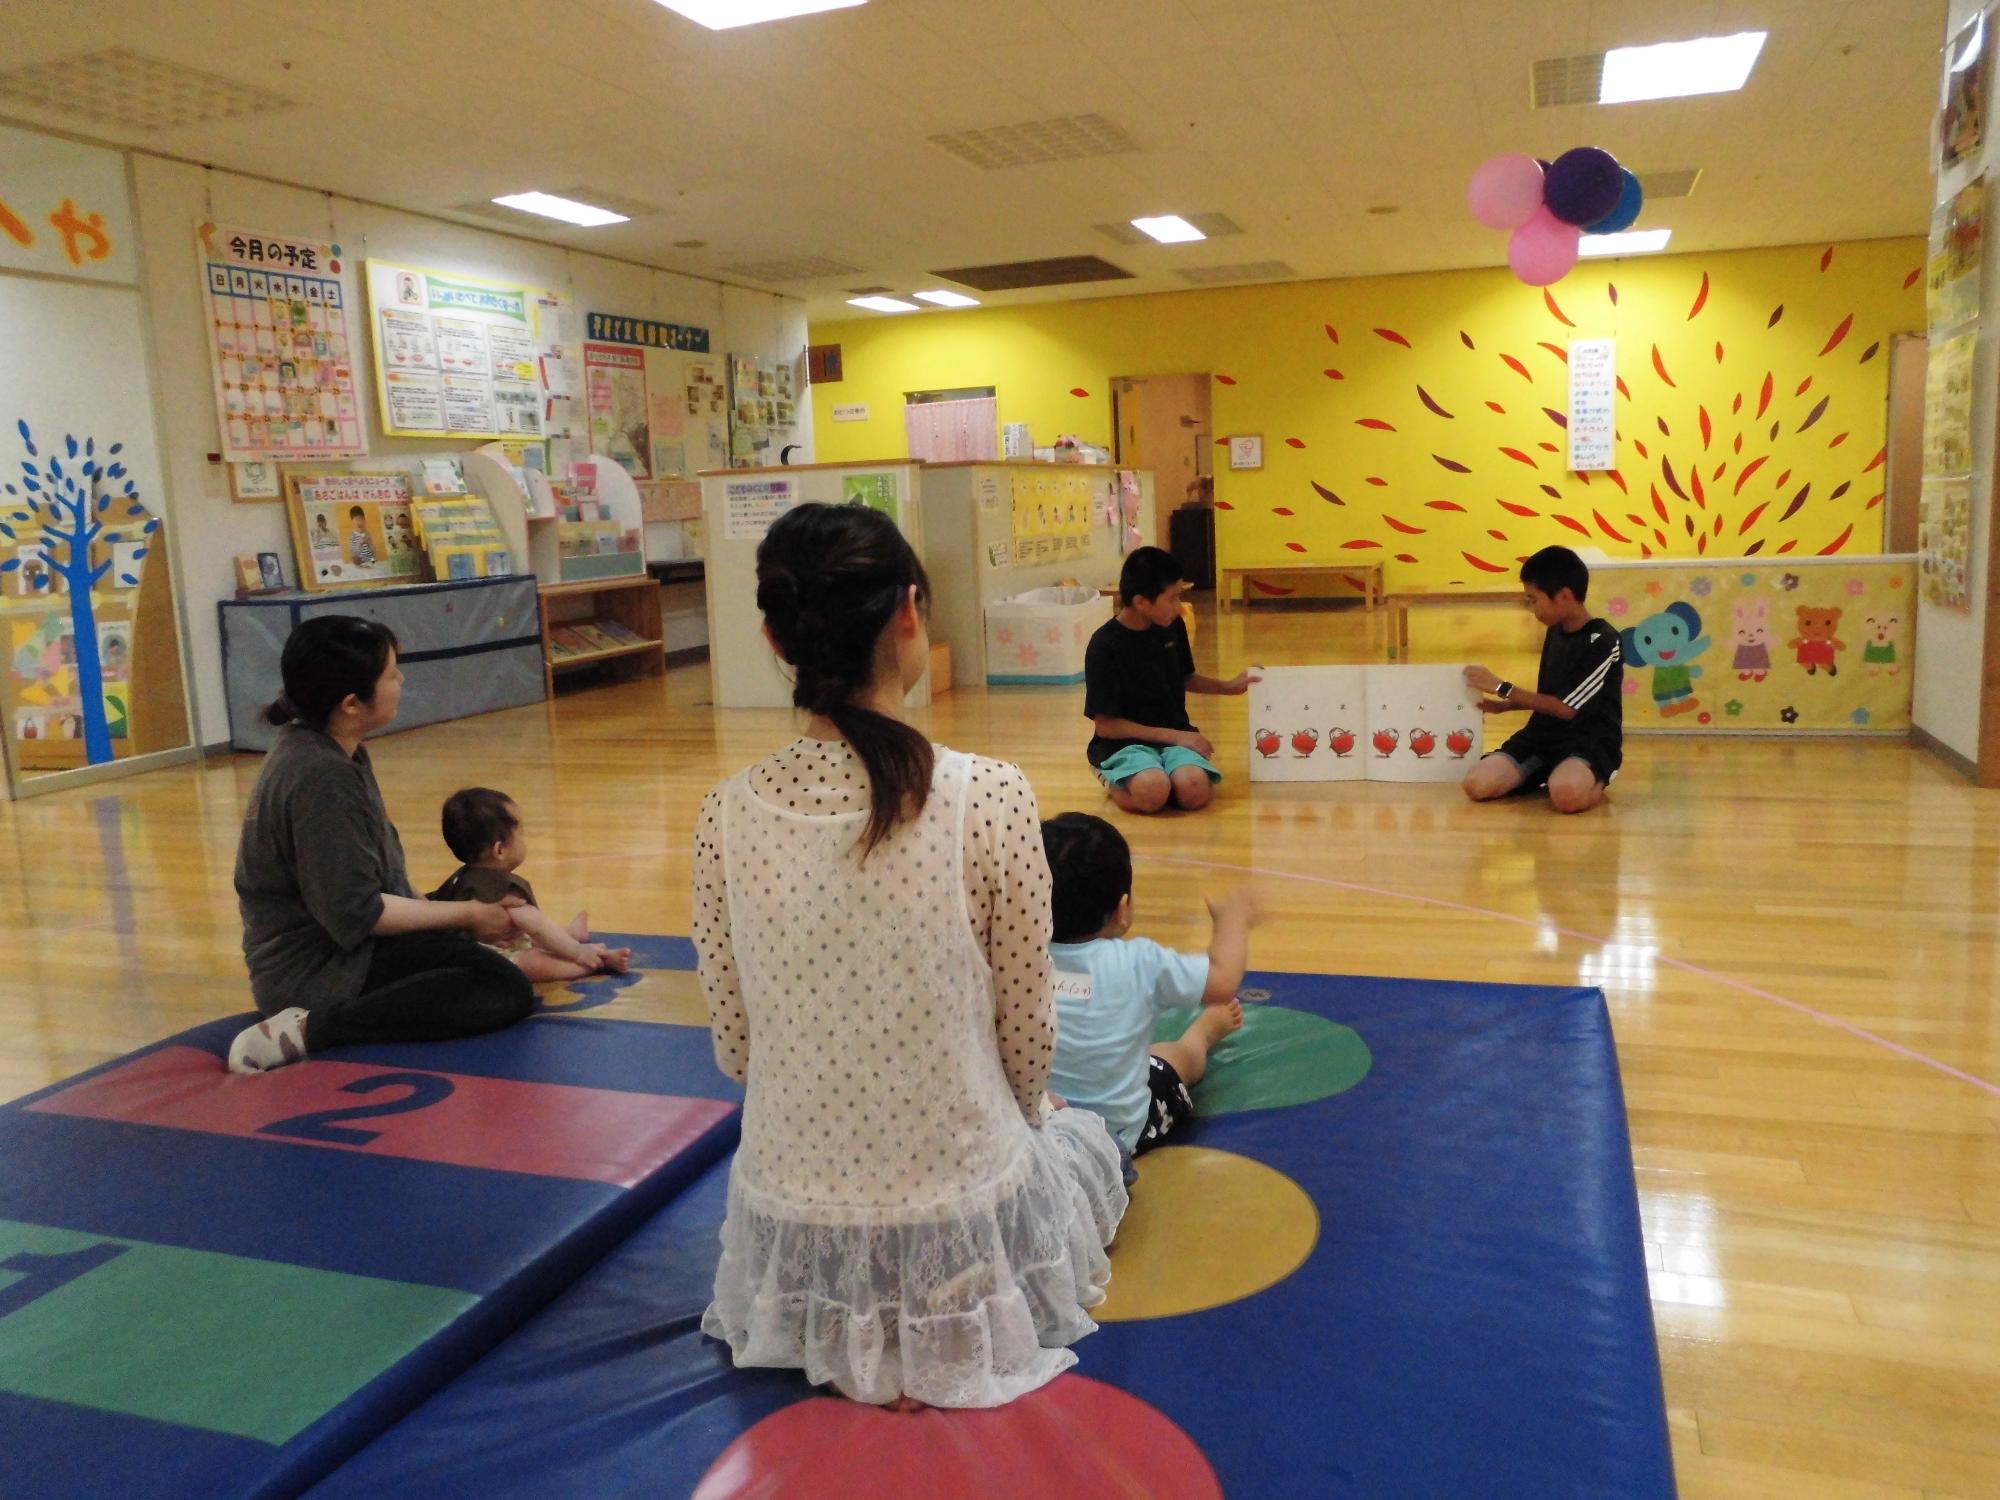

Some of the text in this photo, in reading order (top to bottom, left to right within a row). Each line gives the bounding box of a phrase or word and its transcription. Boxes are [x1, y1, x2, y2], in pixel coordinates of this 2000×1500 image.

[229, 236, 317, 270] 今月の予定
[216, 274, 225, 286] 日
[236, 277, 244, 289] 月
[254, 280, 263, 290] 火
[291, 284, 300, 294] 木
[310, 288, 319, 298] 金
[327, 289, 337, 300] 土
[257, 1072, 455, 1146] 2
